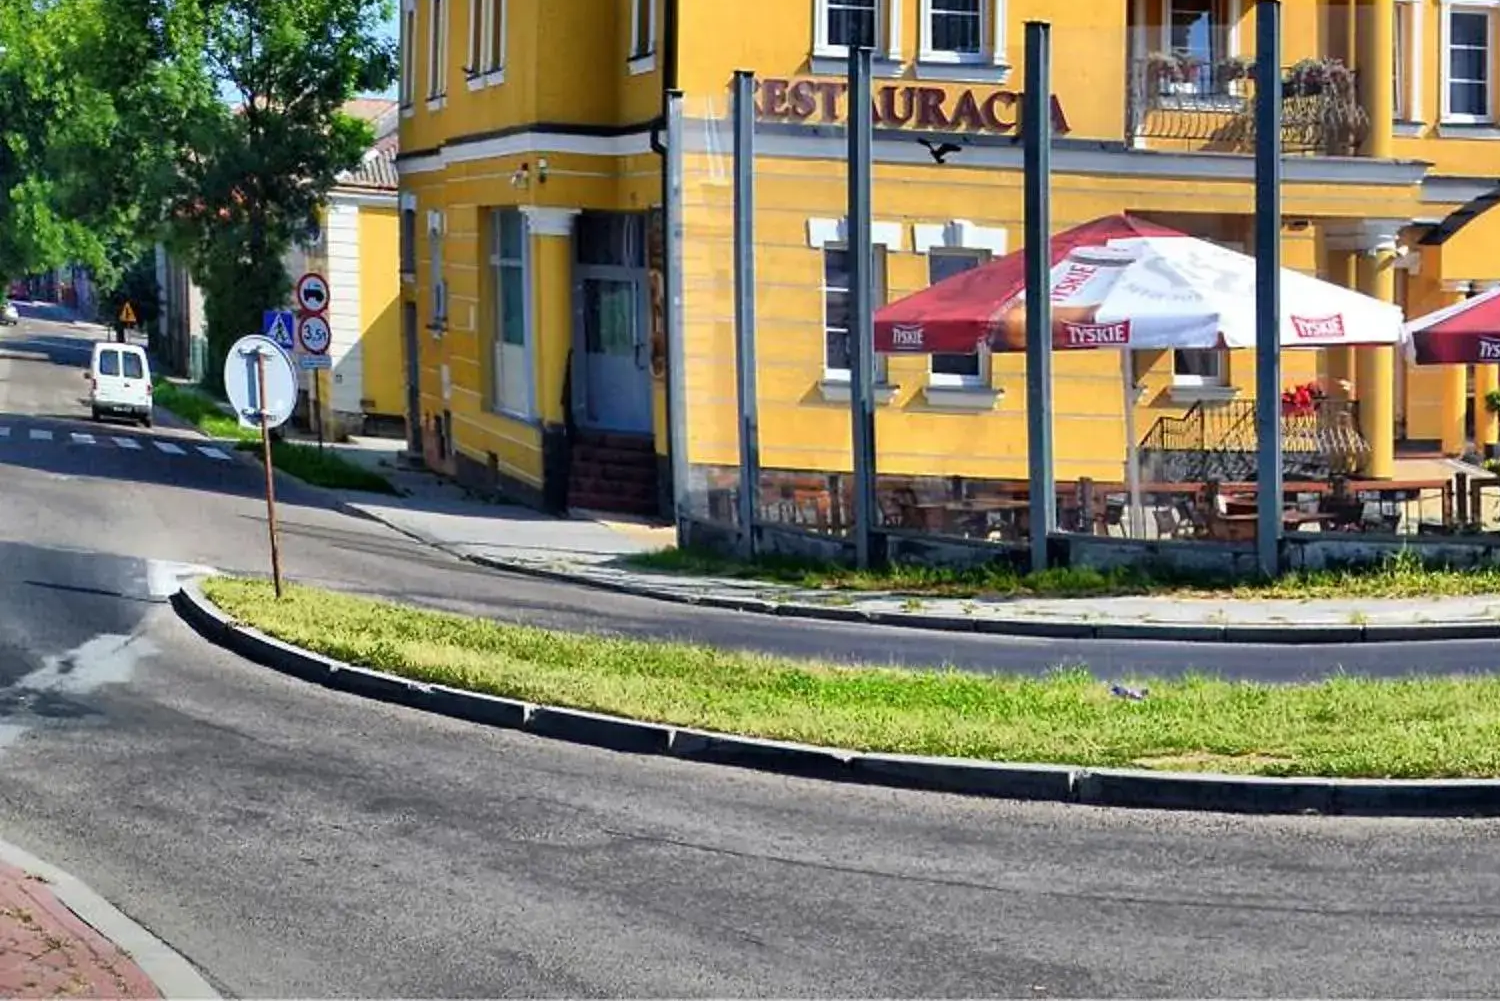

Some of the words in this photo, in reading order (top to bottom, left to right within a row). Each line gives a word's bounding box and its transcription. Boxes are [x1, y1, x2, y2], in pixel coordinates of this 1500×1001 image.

[726, 77, 1072, 135] ESTURACA
[892, 326, 925, 345] TYSKIE
[1068, 324, 1127, 344] TYSKIE
